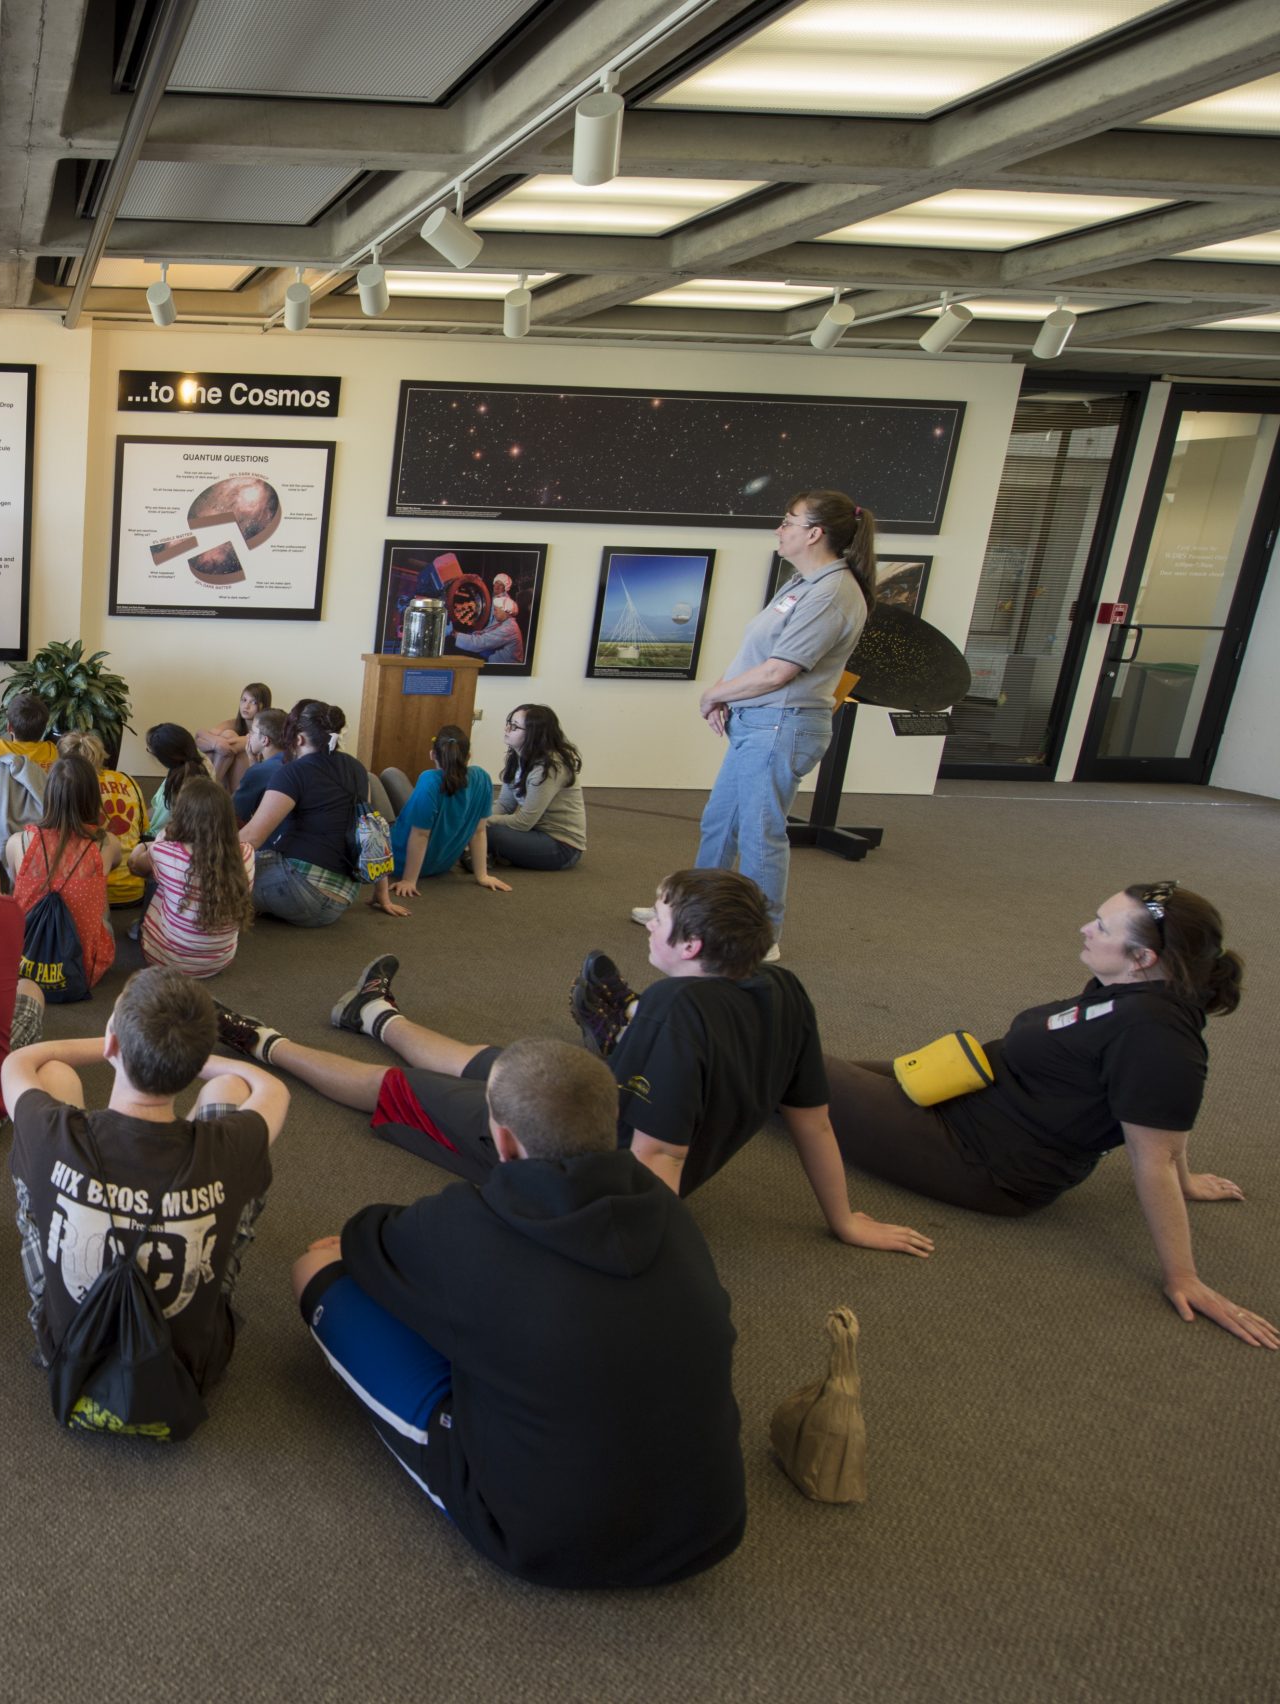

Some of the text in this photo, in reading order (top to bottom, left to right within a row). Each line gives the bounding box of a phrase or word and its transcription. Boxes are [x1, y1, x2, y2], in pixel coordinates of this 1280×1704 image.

[127, 381, 174, 403] ...to
[229, 382, 331, 408] Cosmos
[182, 453, 270, 463] QUANTUM QUESTIONS
[99, 781, 131, 798] ARK
[35, 962, 65, 983] PARK
[50, 1160, 226, 1218] HIX BROS. MUSIC
